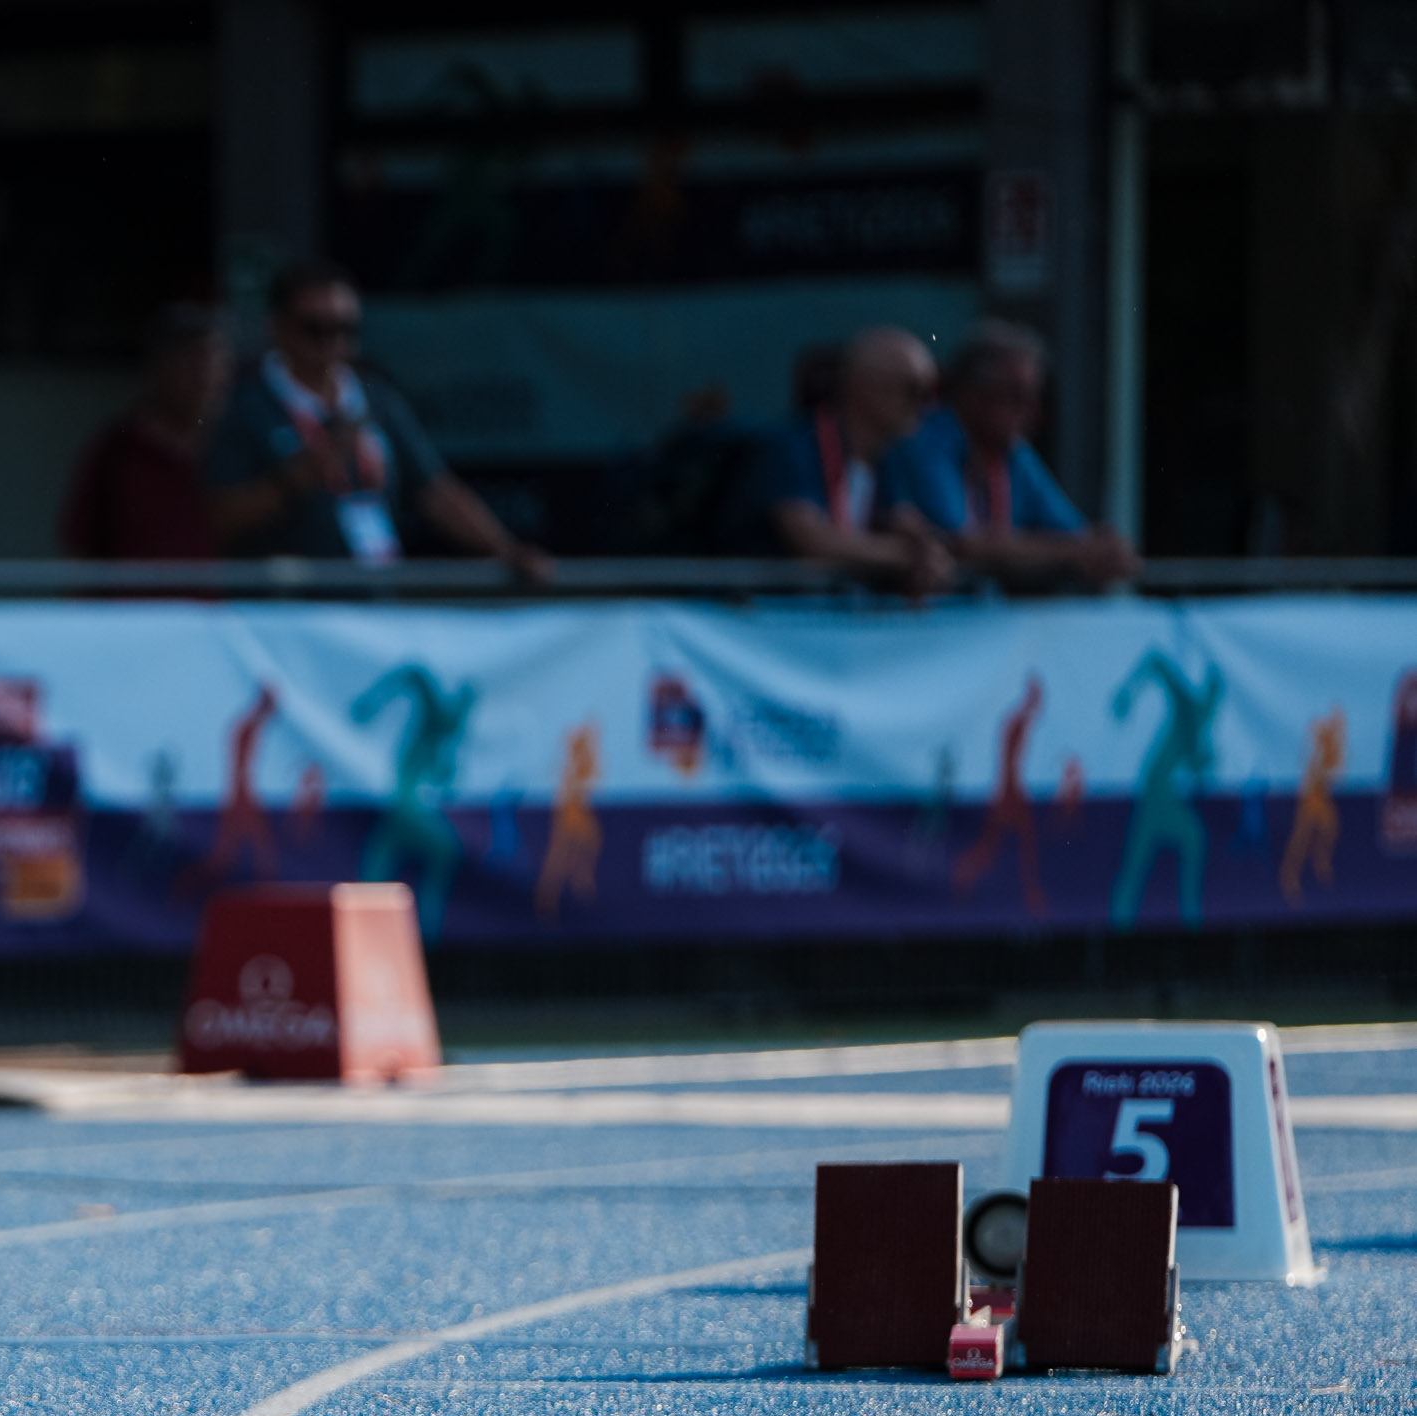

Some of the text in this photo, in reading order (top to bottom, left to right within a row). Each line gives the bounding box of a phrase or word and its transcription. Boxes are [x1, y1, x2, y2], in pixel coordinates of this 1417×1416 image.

[1082, 1070, 1196, 1096] Rieti 2026
[1104, 1099, 1175, 1181] 5
[952, 1357, 995, 1369] OMEGA
